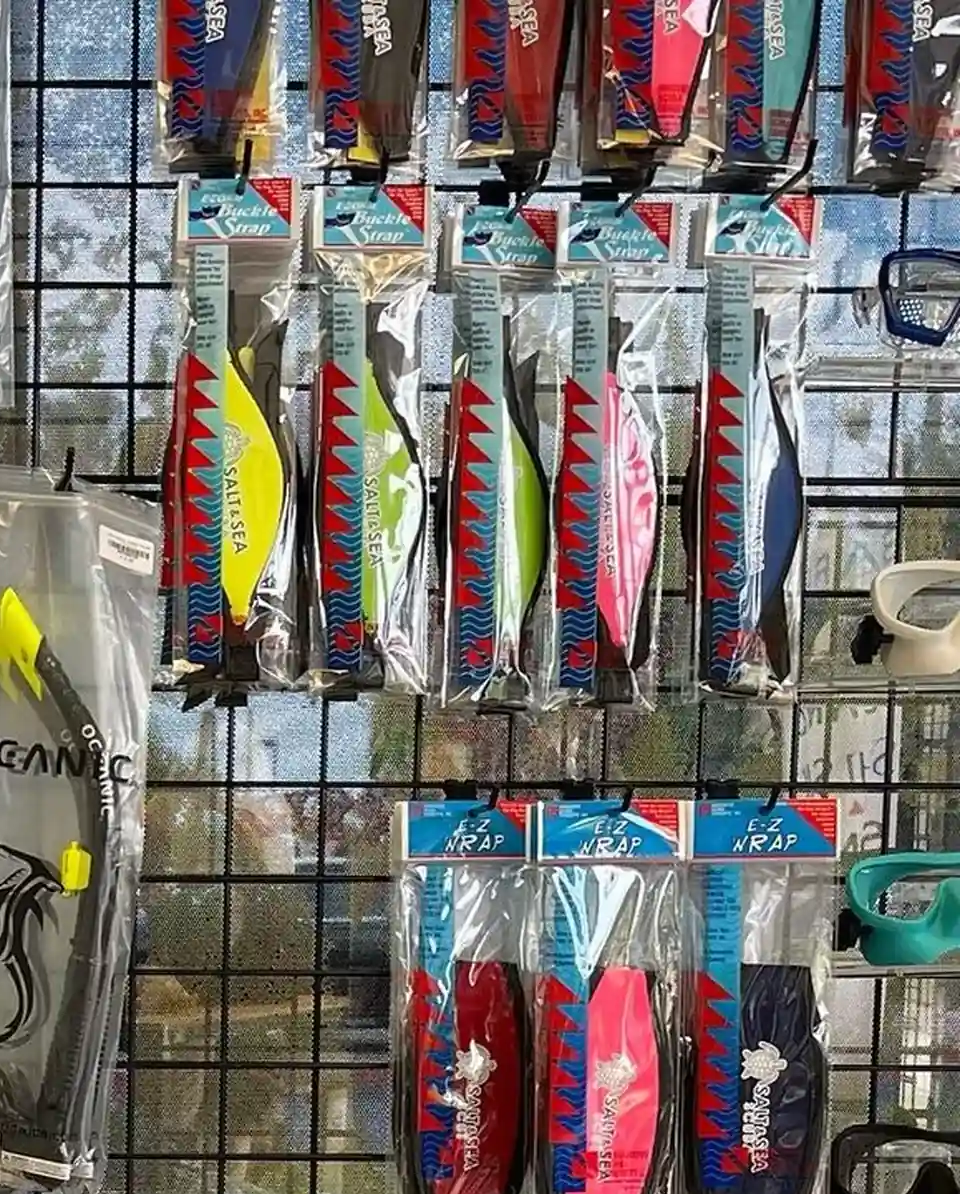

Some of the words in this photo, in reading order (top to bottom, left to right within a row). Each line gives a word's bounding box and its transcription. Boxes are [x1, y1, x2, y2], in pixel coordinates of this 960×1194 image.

[217, 204, 278, 217] Buckle
[351, 210, 411, 224] Buckle
[225, 217, 272, 237] Strap
[360, 225, 405, 244] Strap
[496, 247, 539, 263] Strap
[445, 835, 505, 852] WRAP
[580, 837, 642, 857] WRAP
[733, 834, 798, 853] WRAP
